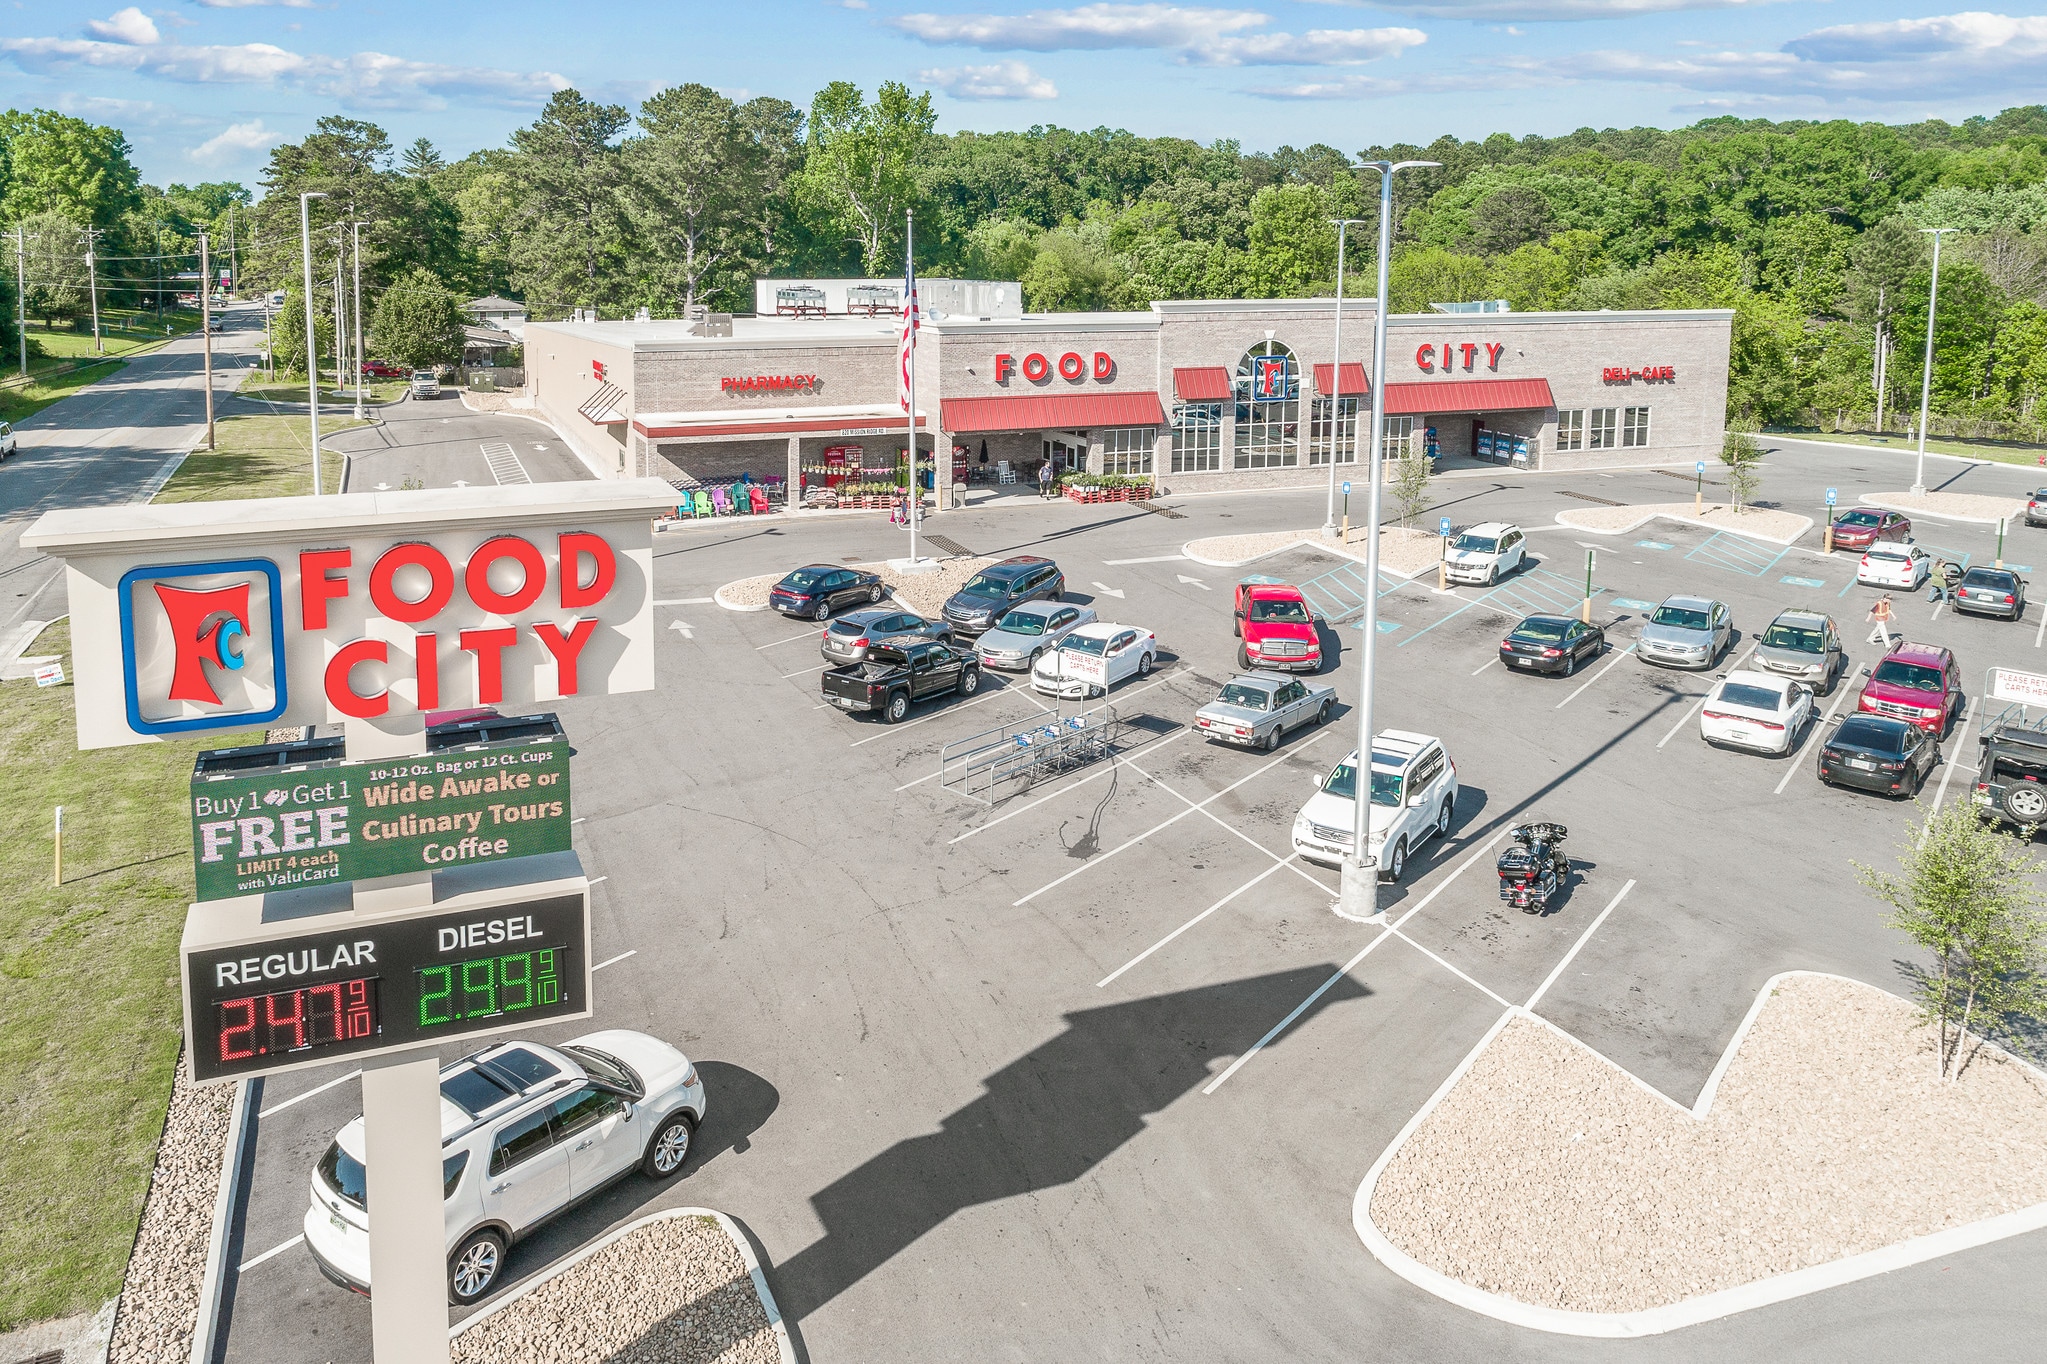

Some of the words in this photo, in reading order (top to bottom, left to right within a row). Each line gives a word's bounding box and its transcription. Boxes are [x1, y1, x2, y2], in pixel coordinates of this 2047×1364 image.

[995, 351, 1113, 382] FOOD
[1415, 342, 1501, 369] CITY
[721, 374, 816, 391] PHARMACY
[299, 532, 617, 631] FOOD
[324, 617, 599, 720] CITY
[1066, 652, 1083, 662] PLEASE
[1999, 673, 2028, 684] PLEASE
[2005, 683, 2030, 693] CARTS
[370, 767, 408, 781] 10-12
[410, 765, 433, 776] Oz.
[435, 762, 462, 774] Bag
[464, 759, 479, 769] or
[482, 756, 498, 768] 12
[500, 754, 518, 765] Ct.
[521, 751, 554, 764] Cups
[195, 796, 244, 818] Buy
[248, 791, 262, 810] 1
[292, 782, 335, 805] Get
[338, 780, 352, 799] 1
[363, 780, 435, 807] Wide
[439, 770, 532, 799] Awake
[537, 772, 560, 786] or
[200, 806, 351, 864] FREE
[361, 810, 483, 841] Culinary
[487, 800, 564, 825] Tours
[236, 857, 283, 876] LIMIT
[286, 856, 297, 869] 4
[300, 850, 339, 866] each
[422, 836, 509, 864] Coffee
[237, 877, 265, 890] with
[266, 864, 340, 886] ValuCard
[438, 915, 544, 952] DIESEL
[216, 940, 377, 988] REGULAR
